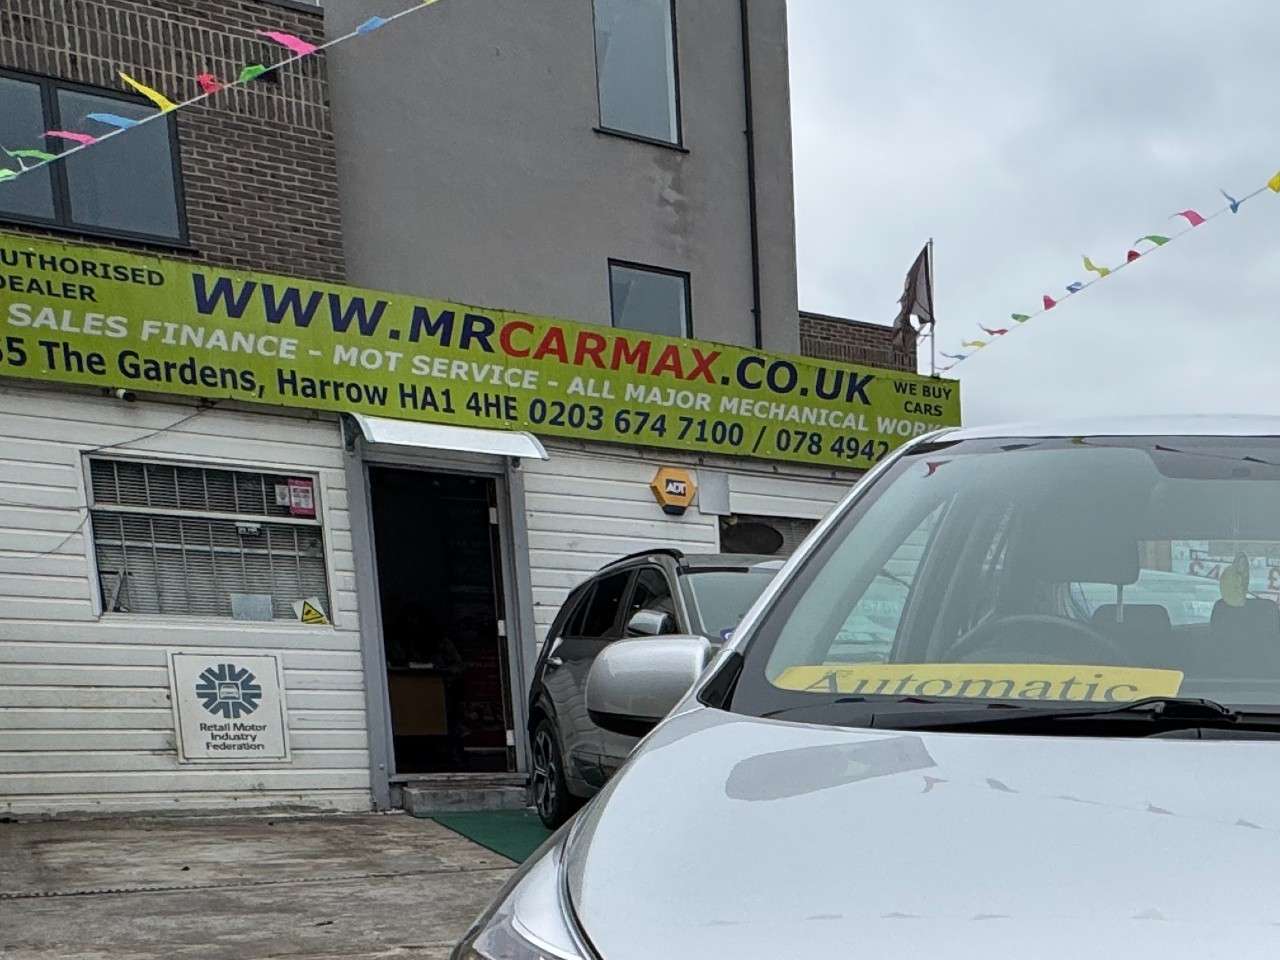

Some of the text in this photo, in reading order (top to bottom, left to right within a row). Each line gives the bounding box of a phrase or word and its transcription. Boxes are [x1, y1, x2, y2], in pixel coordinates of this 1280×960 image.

[0, 249, 165, 286] UTHORISED
[192, 272, 876, 406] WWW.MRCARMAX.CO.UK
[7, 303, 129, 338] SALES
[141, 319, 297, 360] FINANCE
[333, 344, 403, 373] MOT
[411, 353, 538, 390] SERVICE
[567, 375, 616, 399] ALL
[624, 383, 713, 412] MAJOR
[719, 398, 869, 433] MECHANICAL
[0, 335, 27, 367] 5
[38, 340, 107, 376] The
[117, 349, 266, 399] Gardens,
[277, 368, 389, 406] Harrow
[400, 384, 455, 414] HA1
[466, 393, 518, 422] 4HE
[529, 397, 604, 431] 0203
[614, 408, 671, 438] 674
[679, 415, 744, 447] 7100
[776, 430, 823, 456] 078
[894, 380, 953, 401] WE BUY
[903, 401, 944, 417] CARS
[803, 665, 1140, 701] Automatic
[200, 722, 268, 732] Retail Motor
[210, 732, 258, 743] Industry
[205, 742, 266, 751] Federation
